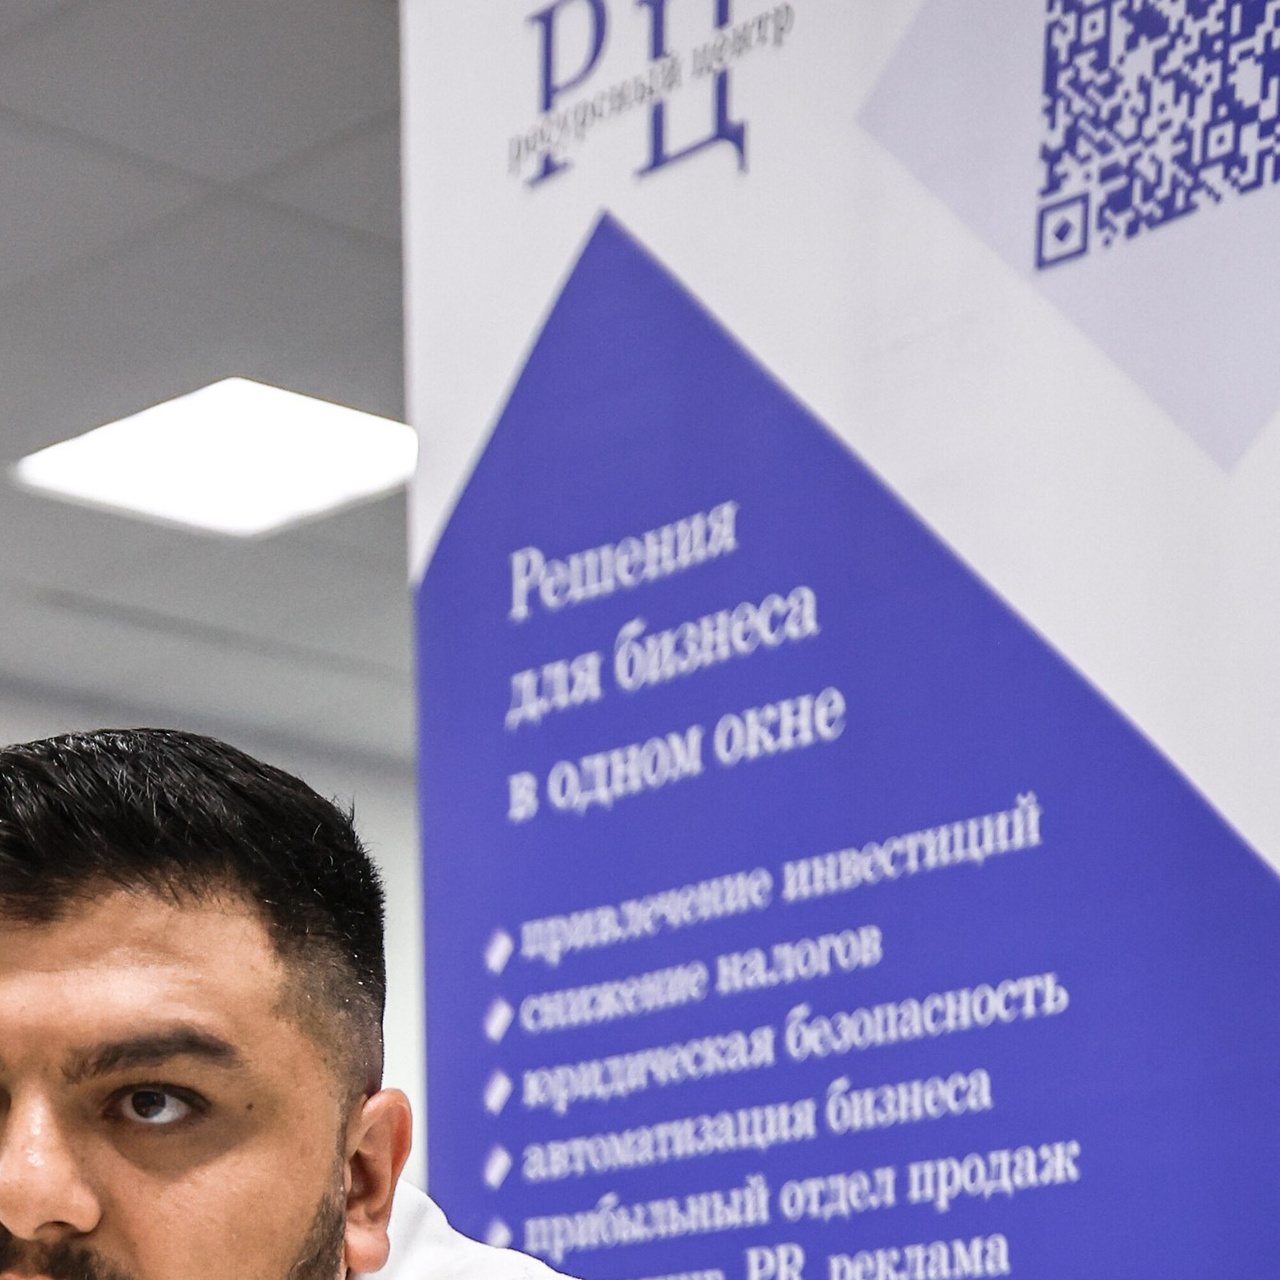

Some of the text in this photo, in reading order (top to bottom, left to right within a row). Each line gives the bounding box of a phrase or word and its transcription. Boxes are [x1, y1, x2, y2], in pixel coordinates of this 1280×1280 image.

[508, 500, 738, 622] Решения
[505, 585, 820, 732] для бизнеса
[508, 686, 846, 824] в одном окне
[521, 790, 1042, 967] привлечение инвестиций
[520, 925, 883, 1033] снижение налогов
[523, 971, 1069, 1116] юридическая безопасность
[522, 1068, 993, 1182] автоматизация бизнеса
[524, 1139, 1081, 1265] прибыльный отдел продаж
